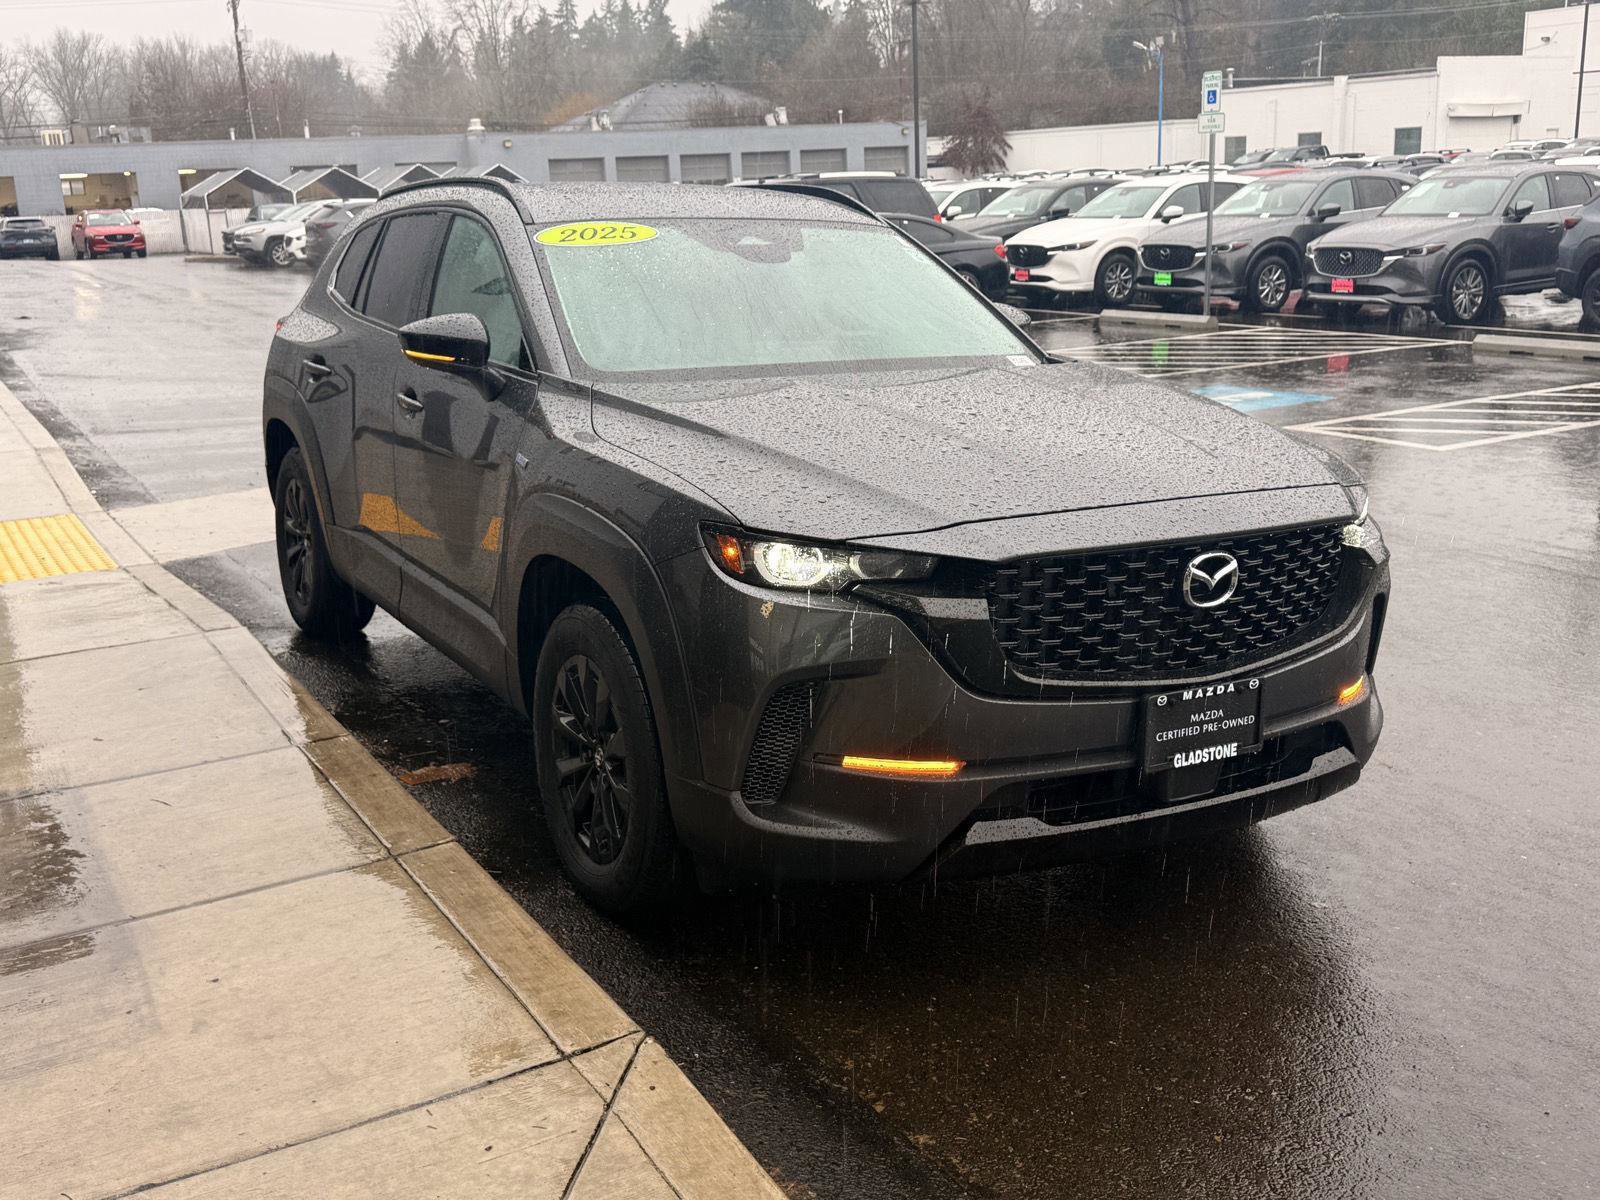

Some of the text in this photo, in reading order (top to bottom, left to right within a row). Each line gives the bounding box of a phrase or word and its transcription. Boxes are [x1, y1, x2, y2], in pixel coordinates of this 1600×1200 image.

[559, 226, 638, 243] 2025
[1182, 683, 1235, 701] MAZDA
[1190, 709, 1224, 723] MAZDA
[1156, 715, 1255, 742] CERTIFIED PRE-OWNED
[1173, 742, 1238, 769] GLADSTONE
